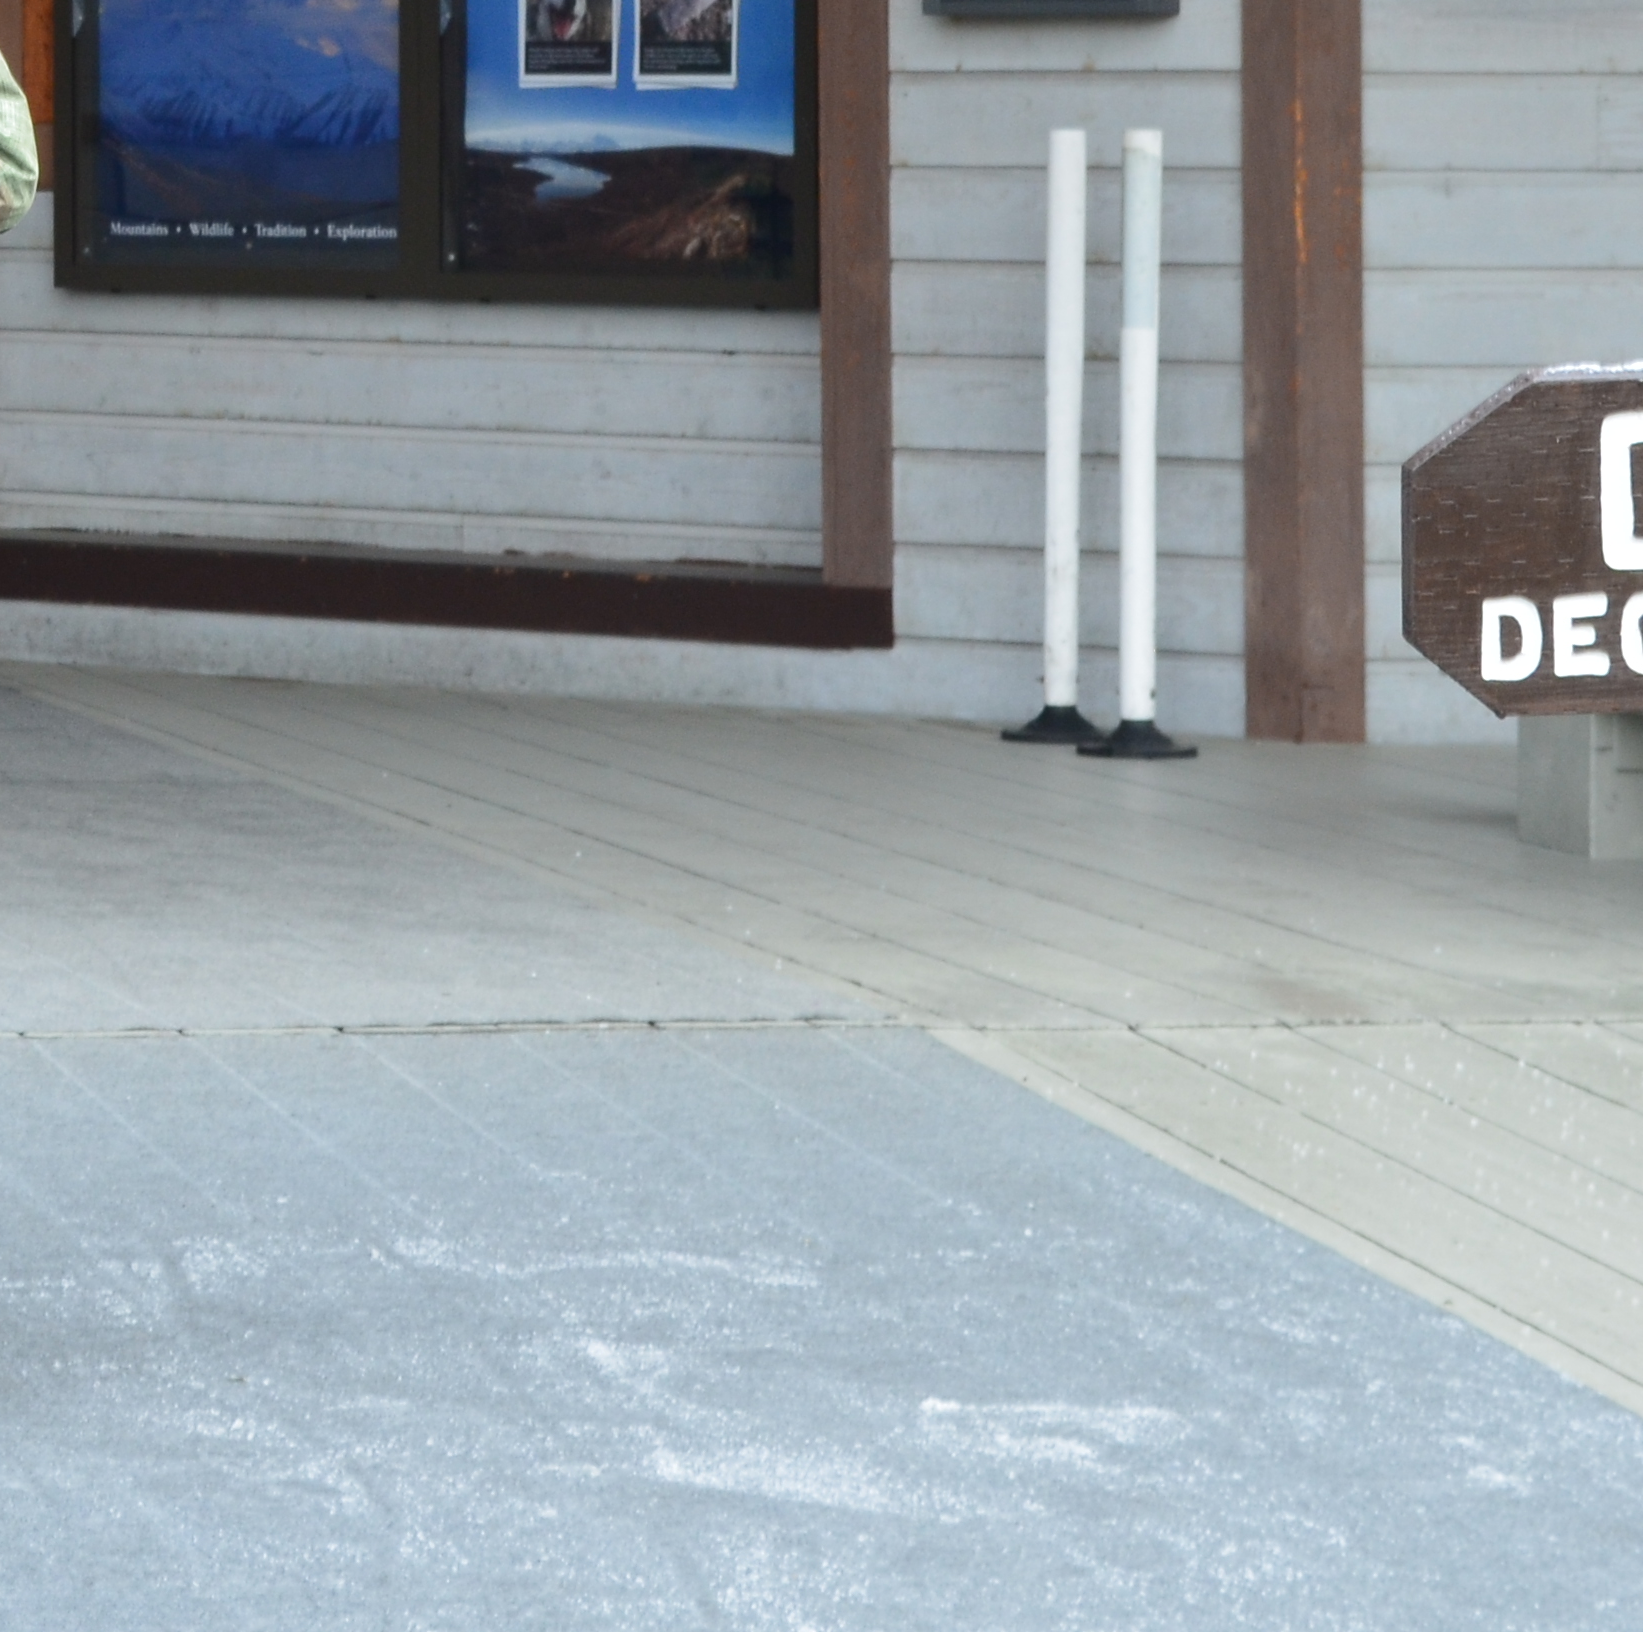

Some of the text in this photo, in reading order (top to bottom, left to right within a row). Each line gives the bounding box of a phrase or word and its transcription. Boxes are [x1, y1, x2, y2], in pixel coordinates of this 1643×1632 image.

[110, 222, 398, 240] Mountains Wildlife Tradition Exploration
